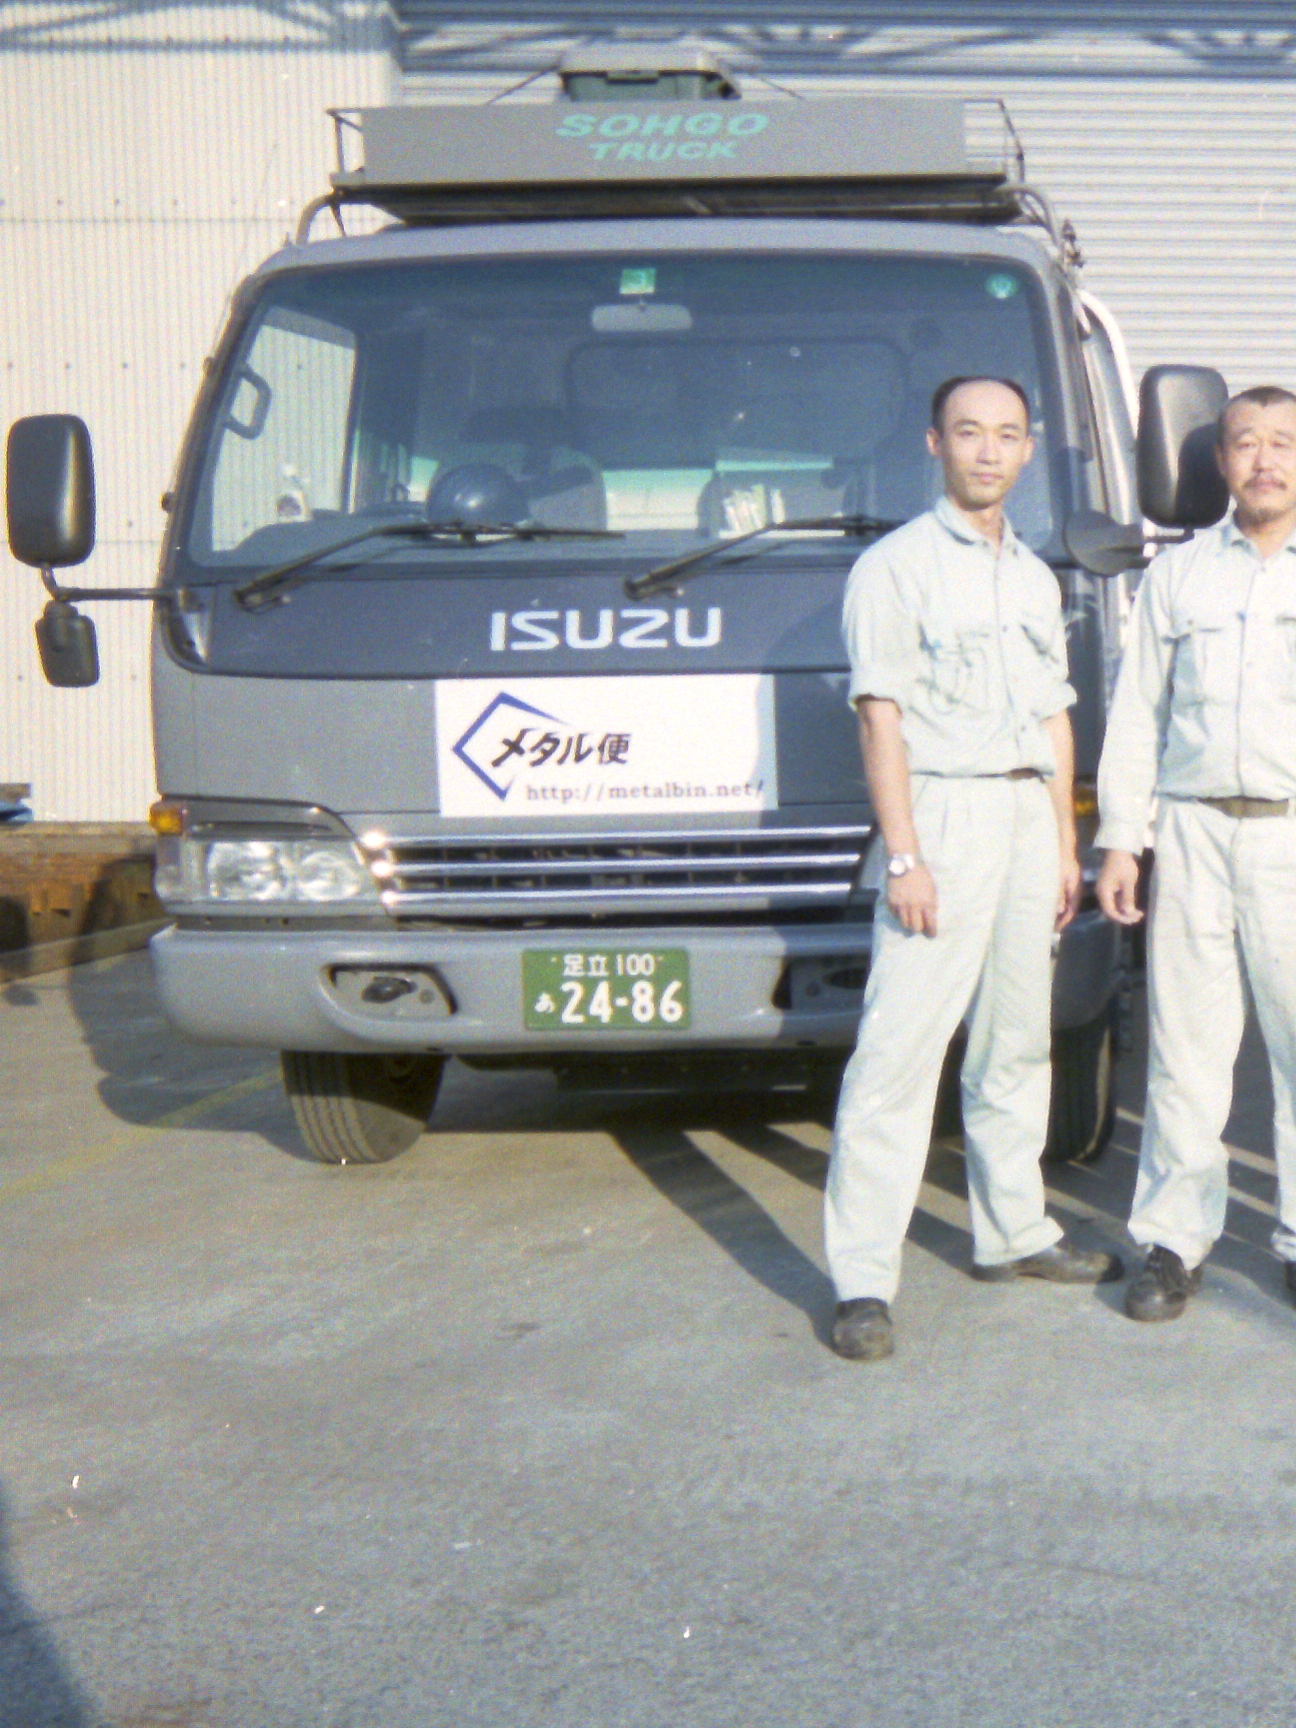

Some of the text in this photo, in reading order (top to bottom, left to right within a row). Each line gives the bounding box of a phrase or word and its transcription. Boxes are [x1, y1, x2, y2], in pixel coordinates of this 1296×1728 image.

[555, 112, 769, 137] SOHGO
[589, 141, 737, 161] TRUCK
[490, 607, 721, 651] ISUZU
[491, 728, 632, 767] メタル便
[526, 779, 763, 803] http://metalbin.net/
[562, 953, 656, 977] 足立 100
[560, 980, 683, 1024] 24-86
